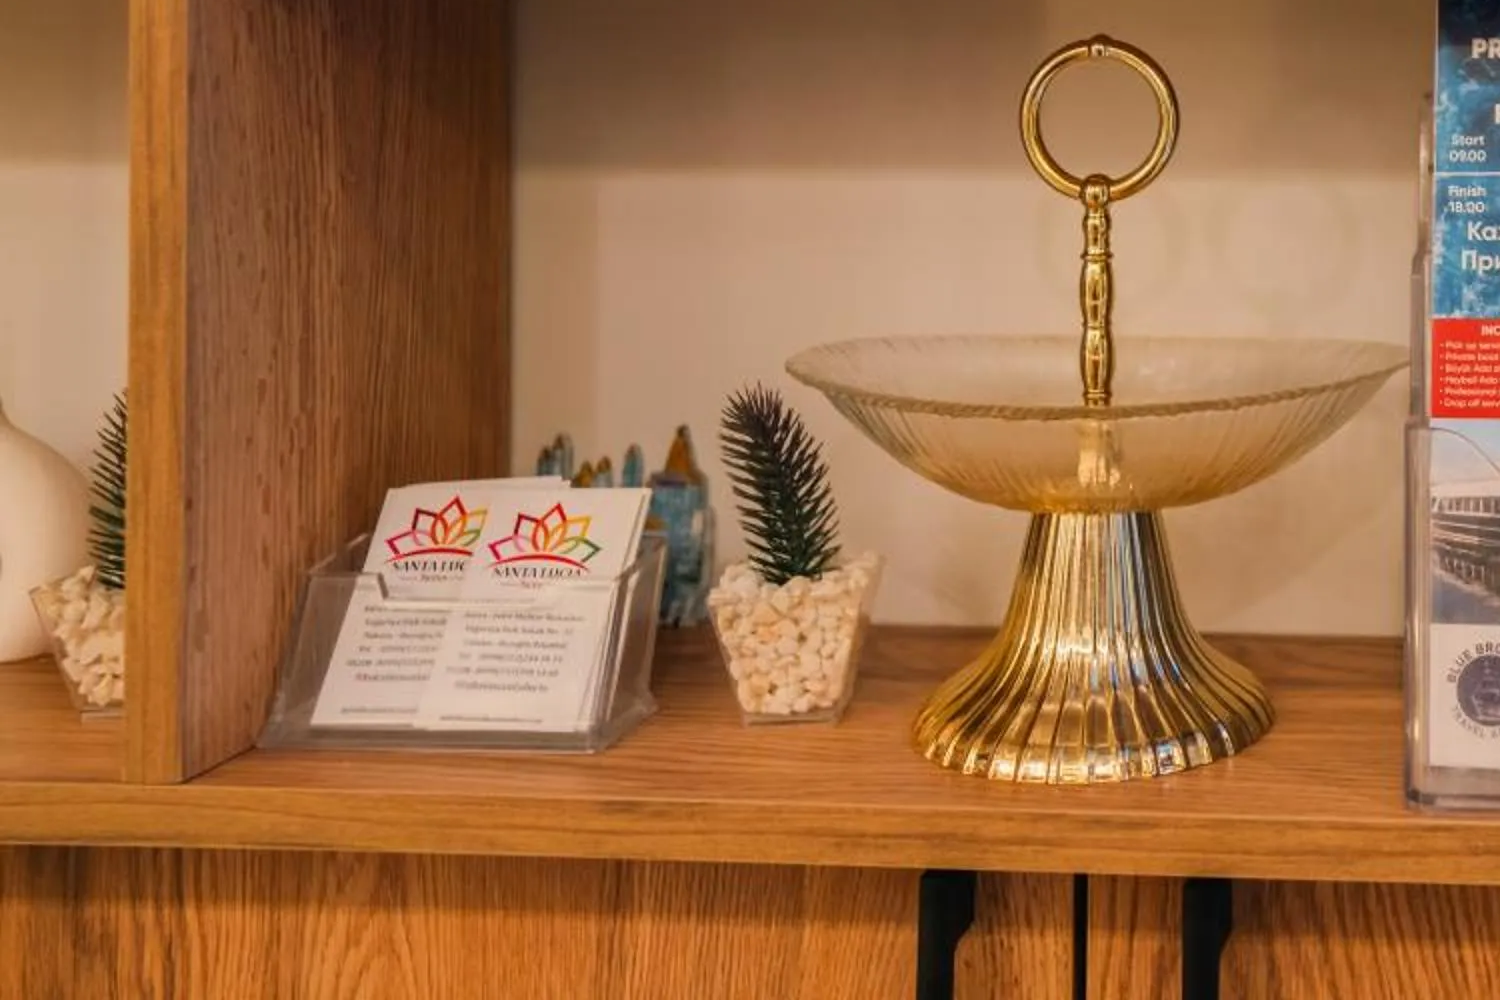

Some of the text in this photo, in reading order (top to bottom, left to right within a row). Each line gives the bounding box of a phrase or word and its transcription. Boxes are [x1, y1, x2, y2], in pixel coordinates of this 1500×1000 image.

[1451, 134, 1486, 147] Start
[1448, 185, 1487, 198] Finish
[1446, 649, 1473, 683] BLUE
